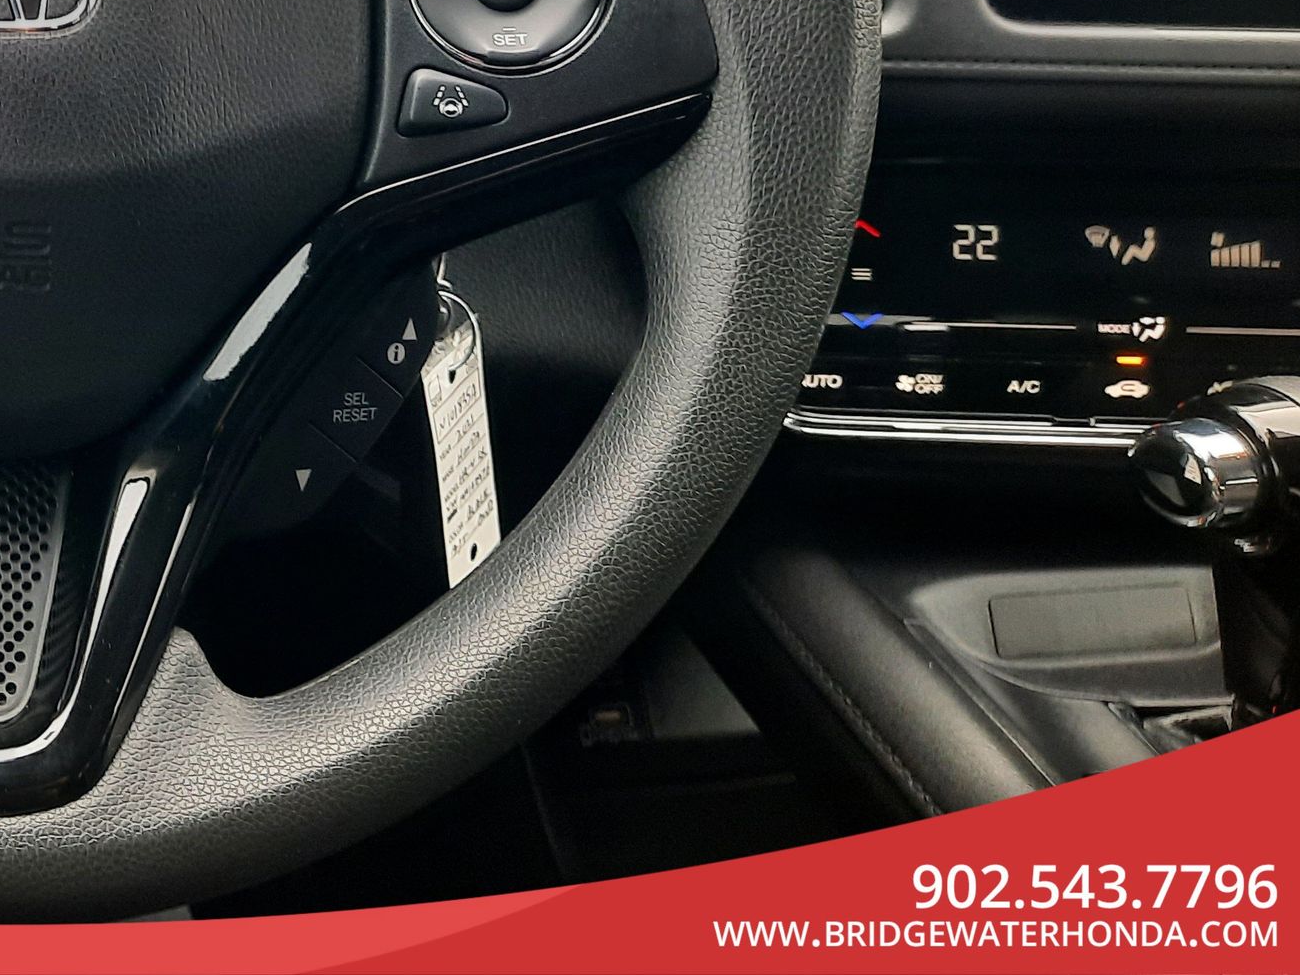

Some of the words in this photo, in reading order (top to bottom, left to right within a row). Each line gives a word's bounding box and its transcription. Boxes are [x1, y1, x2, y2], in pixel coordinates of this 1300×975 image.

[492, 33, 529, 47] SET
[952, 224, 1000, 262] 22
[1007, 380, 1042, 395] A/C
[343, 391, 369, 406] SEL
[332, 407, 377, 423] RESET
